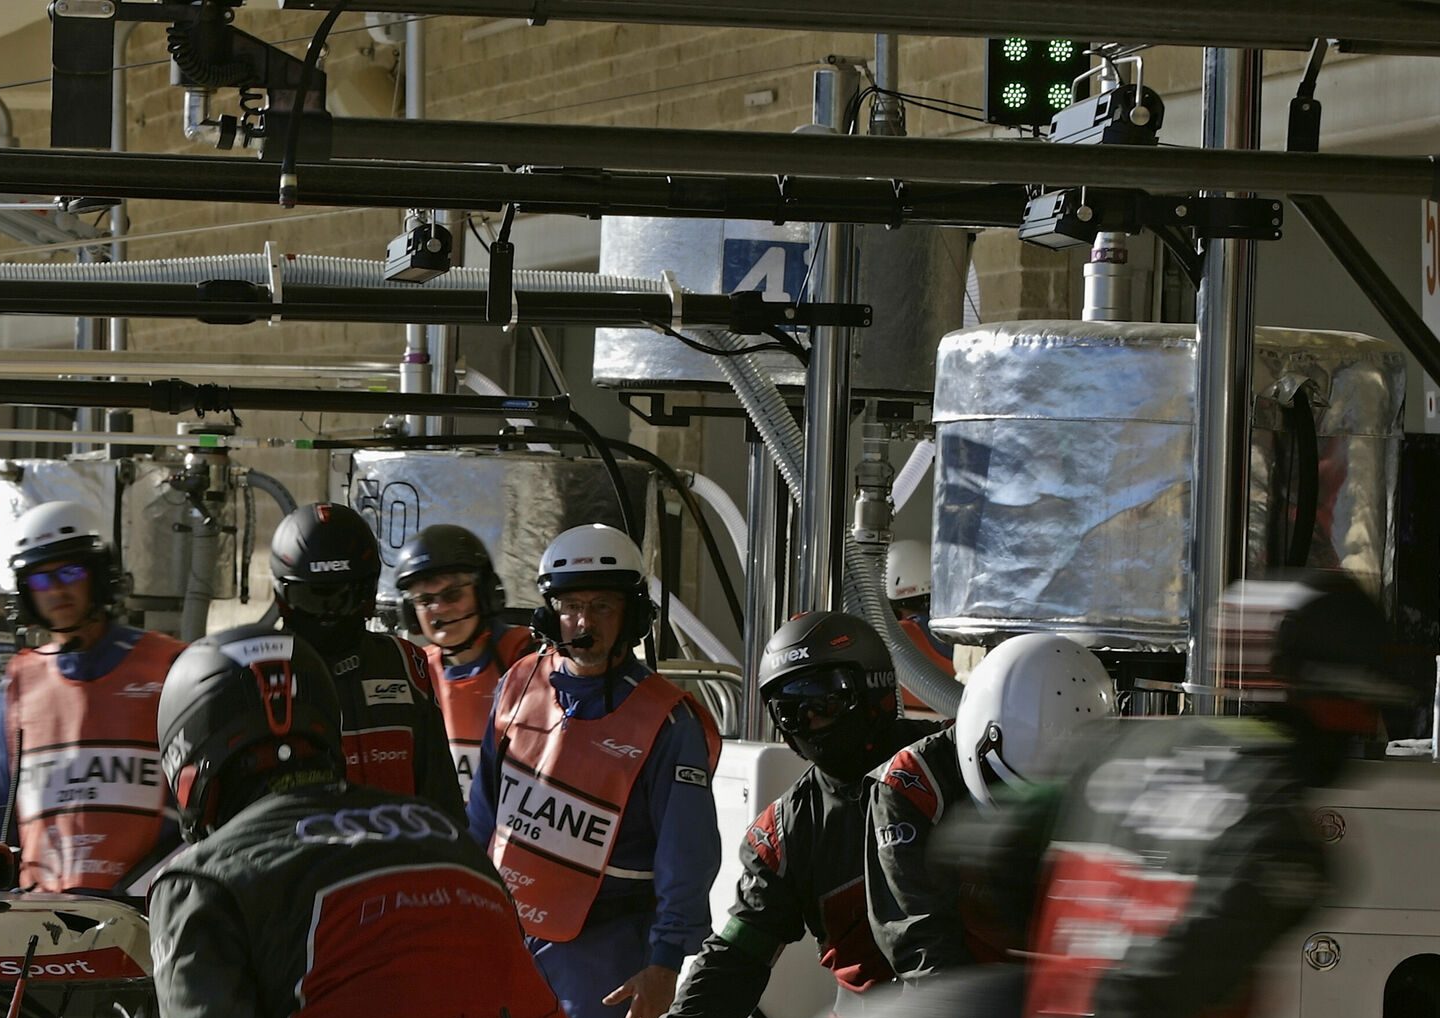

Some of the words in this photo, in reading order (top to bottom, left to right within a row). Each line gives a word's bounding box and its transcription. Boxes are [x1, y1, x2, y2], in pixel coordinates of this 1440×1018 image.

[310, 560, 351, 572] uvex
[771, 646, 810, 669] uvex
[375, 684, 408, 694] WEC
[370, 749, 409, 764] Sport
[602, 738, 643, 758] WEC
[66, 756, 159, 786] LANE
[517, 786, 612, 847] LANE
[505, 815, 542, 841] 2016
[518, 875, 536, 888] OF
[395, 887, 452, 909] Audi
[0, 959, 96, 978] Sport
